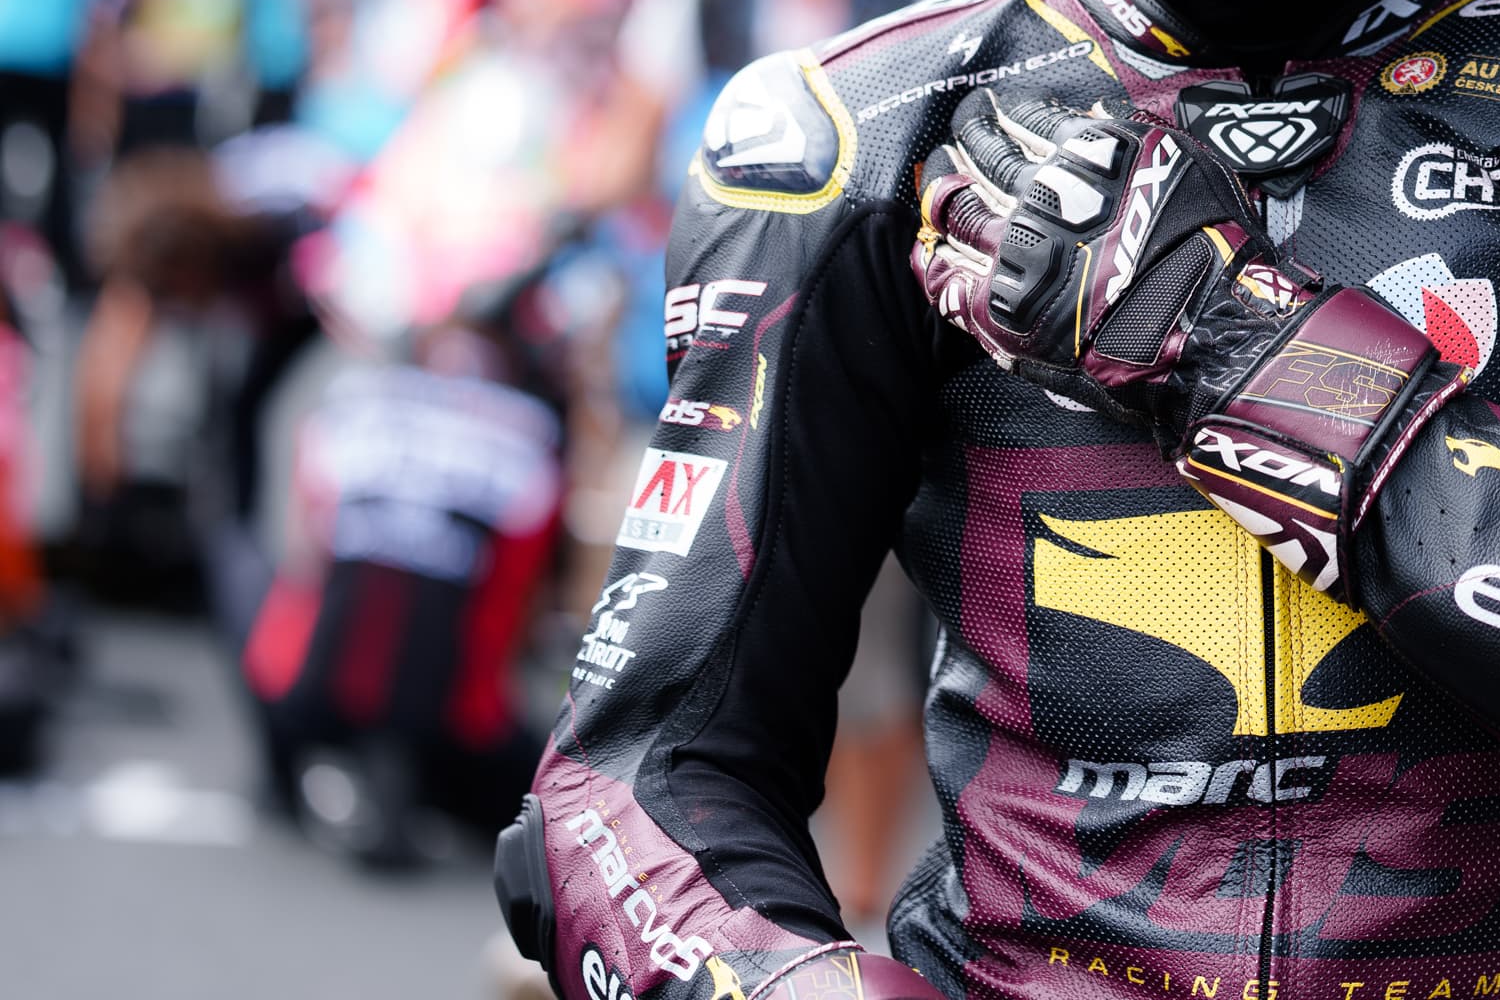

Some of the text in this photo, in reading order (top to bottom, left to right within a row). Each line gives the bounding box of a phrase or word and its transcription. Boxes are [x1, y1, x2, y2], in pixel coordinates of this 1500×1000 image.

[856, 40, 1093, 125] SCORPION EXO
[1204, 99, 1321, 119] IXON
[1193, 426, 1342, 497] IXON
[1061, 755, 1326, 806] marc
[1048, 946, 1280, 1000] RACING
